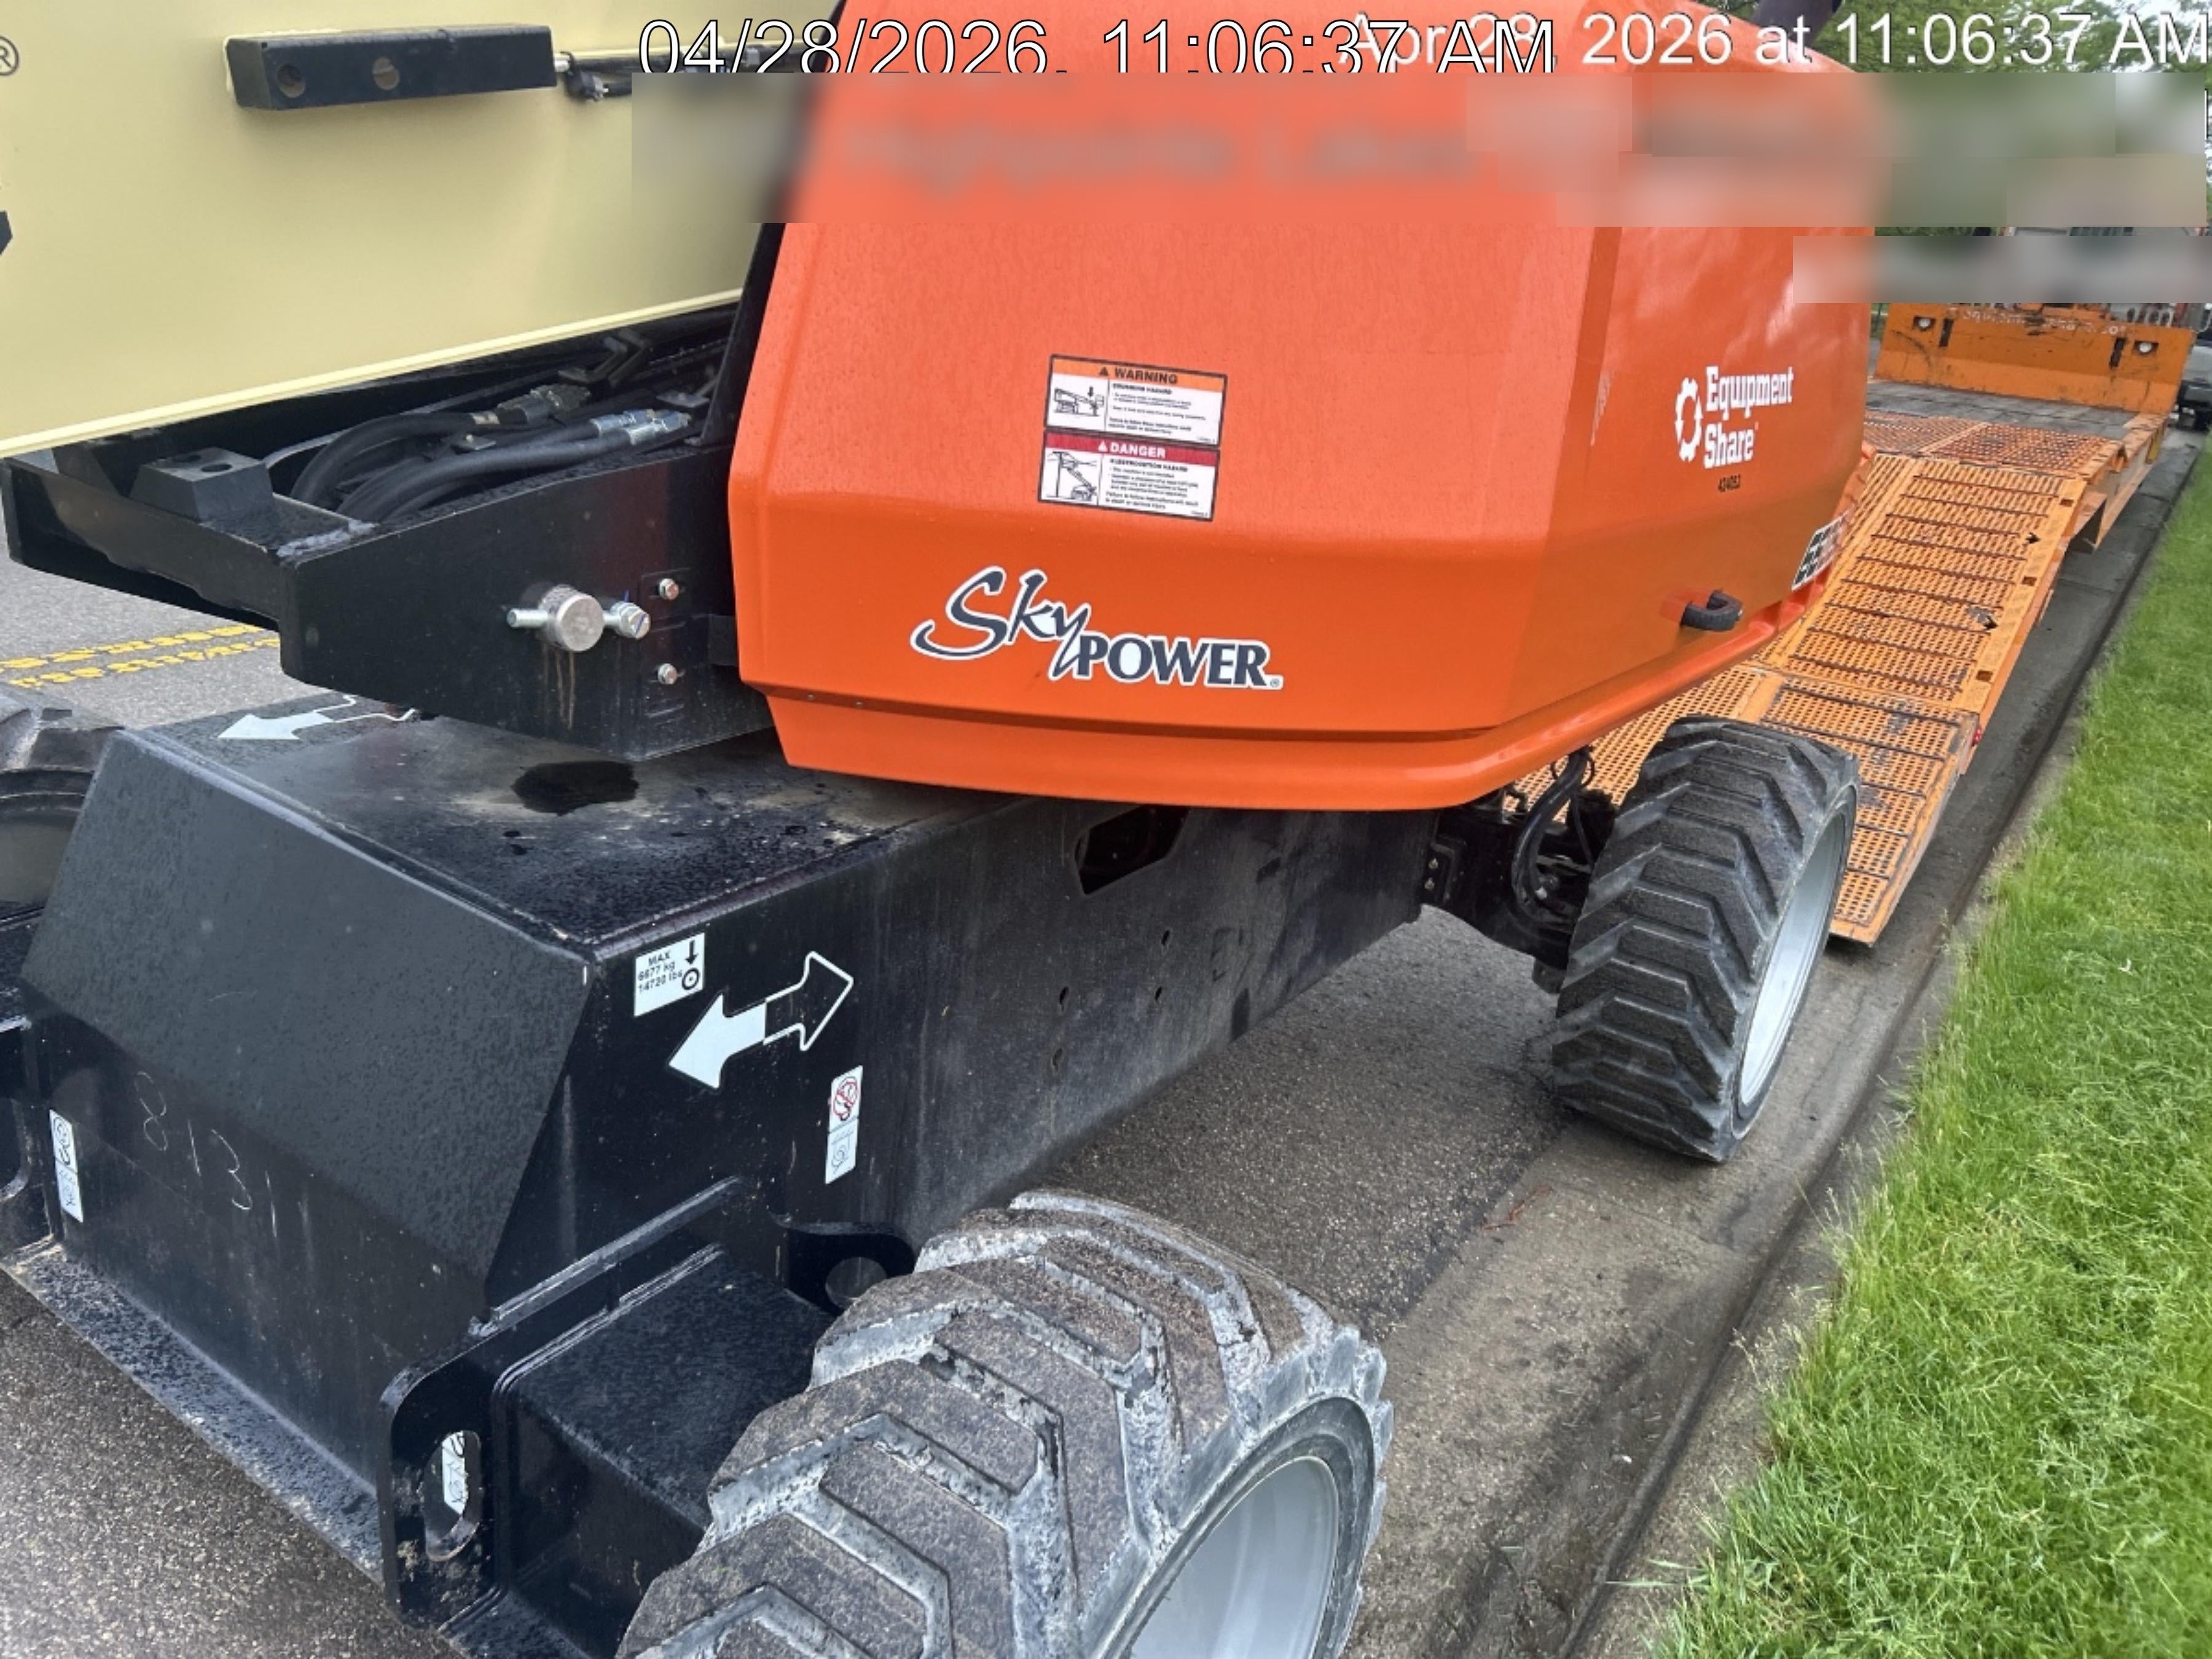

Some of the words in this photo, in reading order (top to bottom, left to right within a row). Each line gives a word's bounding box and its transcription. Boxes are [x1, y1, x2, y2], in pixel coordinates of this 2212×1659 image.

[1115, 367, 1178, 384] WARNING
[1704, 366, 1794, 421] Equipment
[1110, 442, 1166, 458] DANGER
[1704, 422, 1755, 469] Share
[648, 949, 671, 967] MAX
[664, 960, 675, 972] kg
